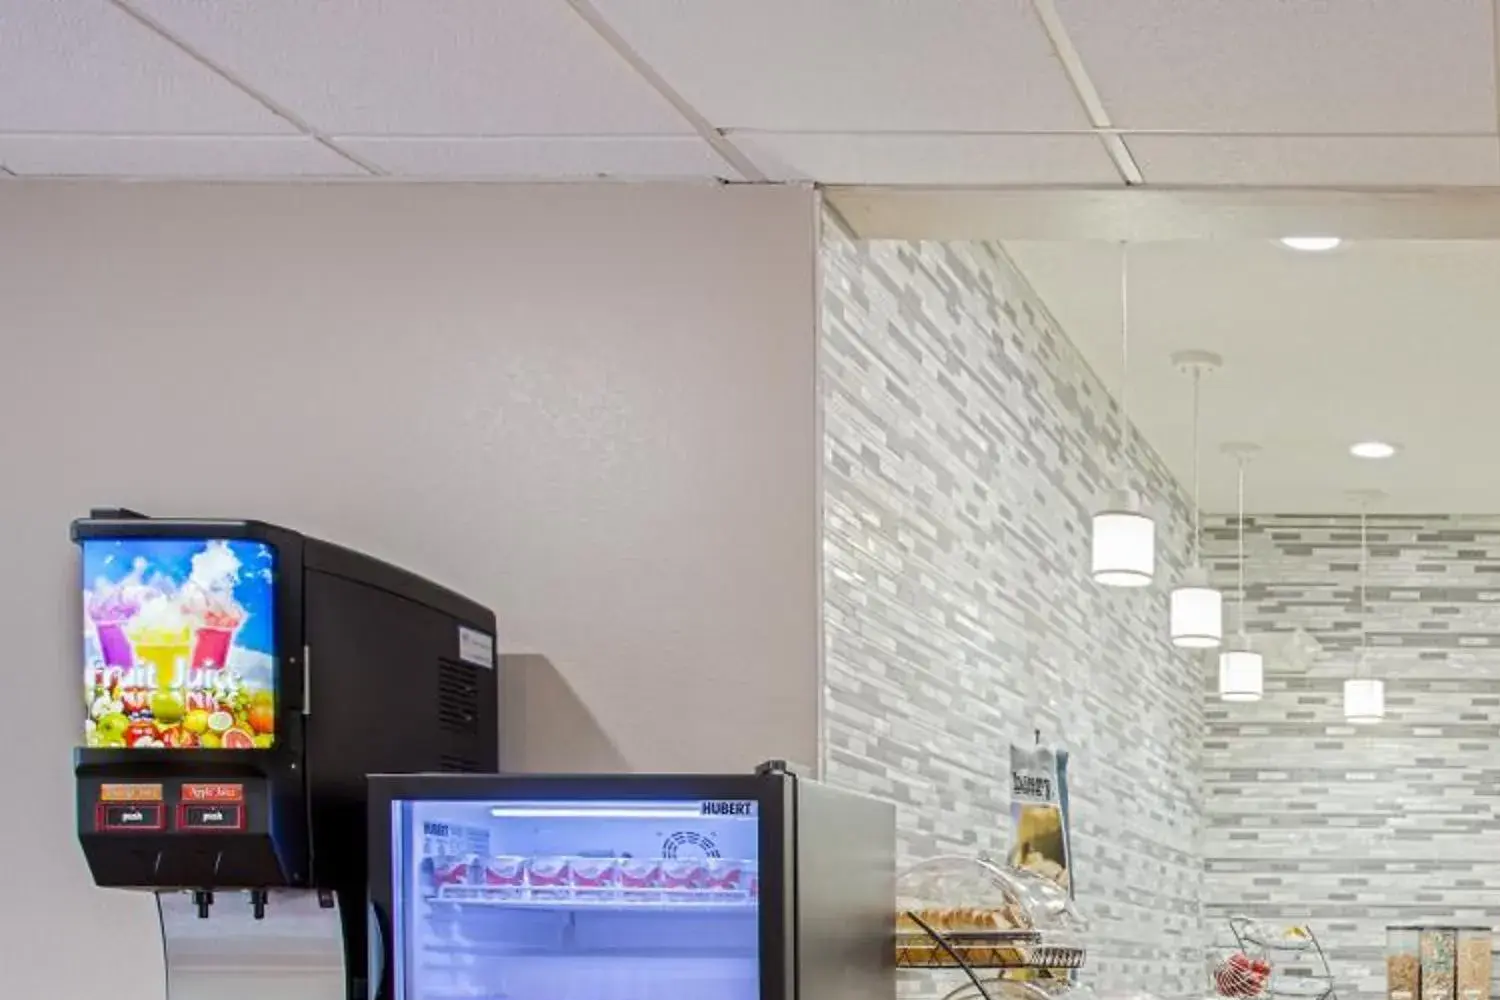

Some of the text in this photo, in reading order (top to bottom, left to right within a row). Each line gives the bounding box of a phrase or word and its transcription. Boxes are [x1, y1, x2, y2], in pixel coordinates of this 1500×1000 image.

[169, 656, 241, 690] Juice
[702, 802, 751, 815] HUBERT
[122, 809, 143, 822] push
[203, 809, 223, 822] push
